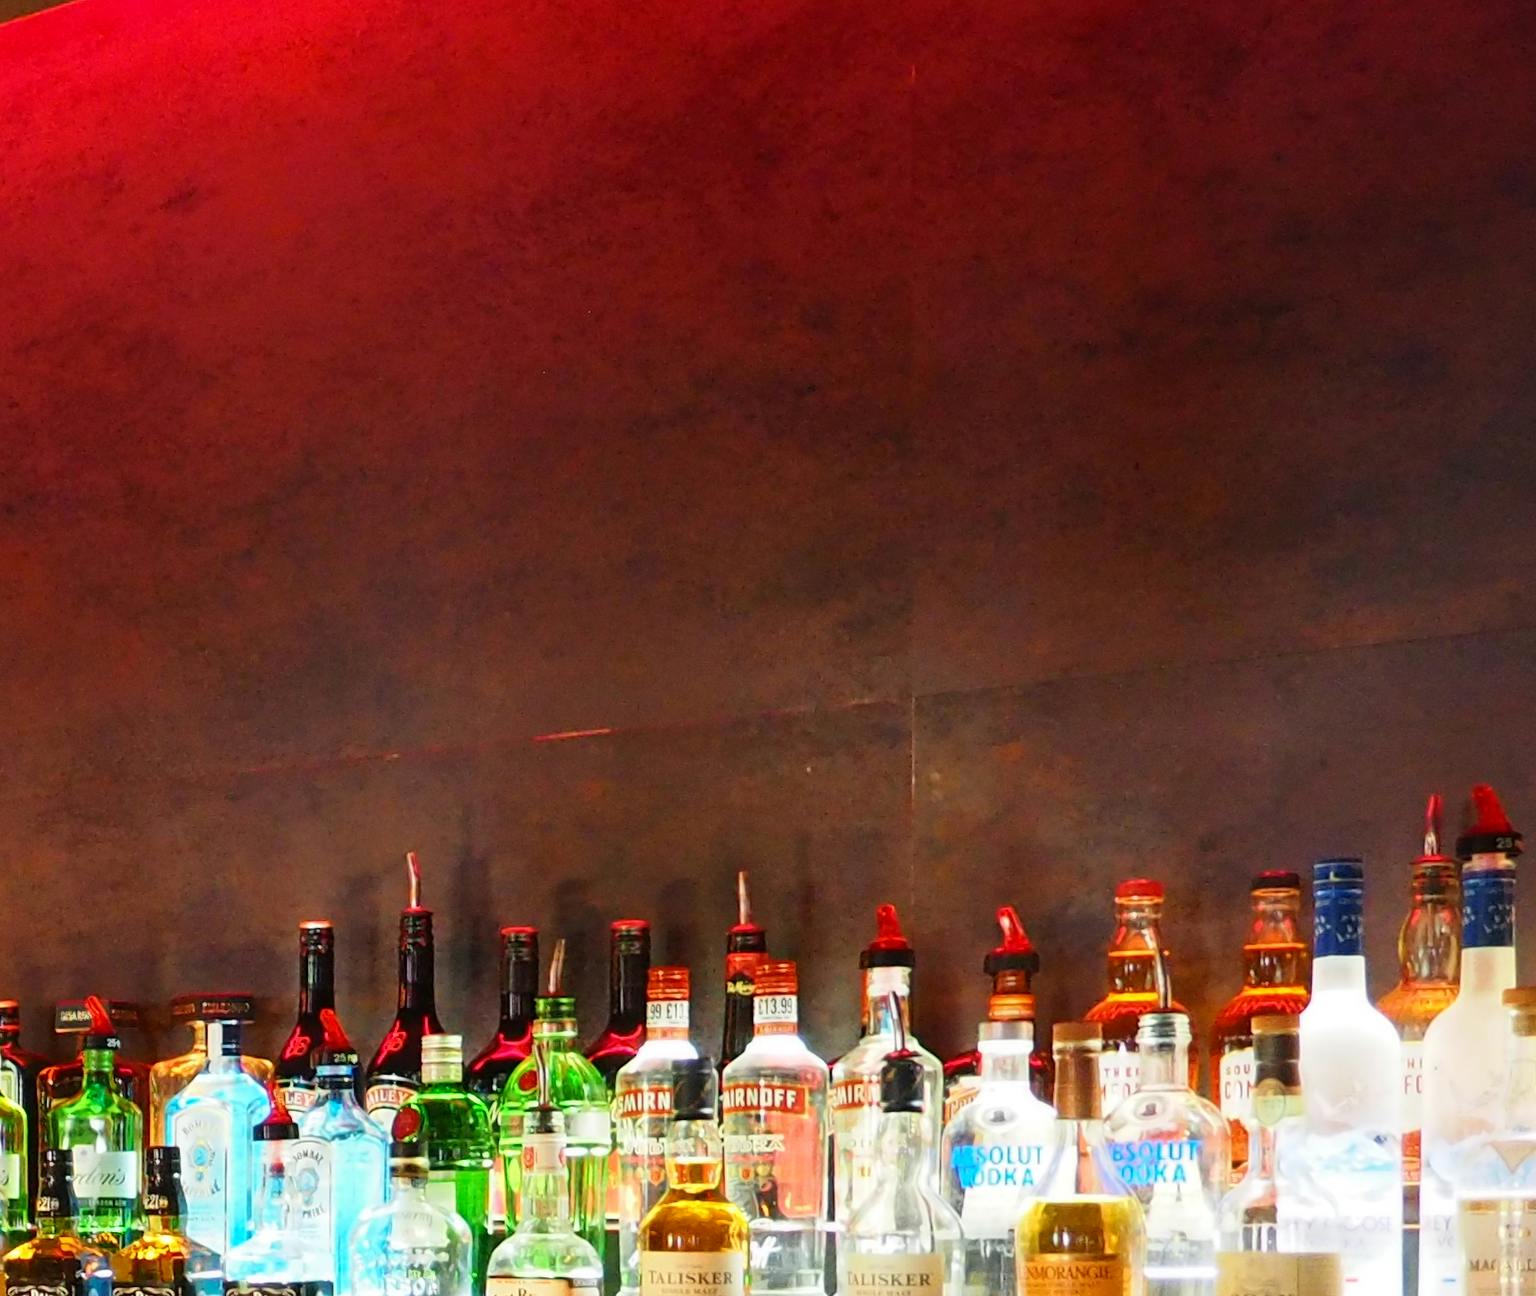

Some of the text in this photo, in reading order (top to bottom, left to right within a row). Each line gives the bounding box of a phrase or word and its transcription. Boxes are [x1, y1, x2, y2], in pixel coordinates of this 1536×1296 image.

[758, 997, 793, 1015] £13.99
[366, 1088, 408, 1107] AILEY
[618, 1091, 671, 1112] SMIRN
[832, 1084, 880, 1107] SMIRN
[648, 1270, 734, 1285] TALISKER
[847, 1271, 932, 1287] TALISKER
